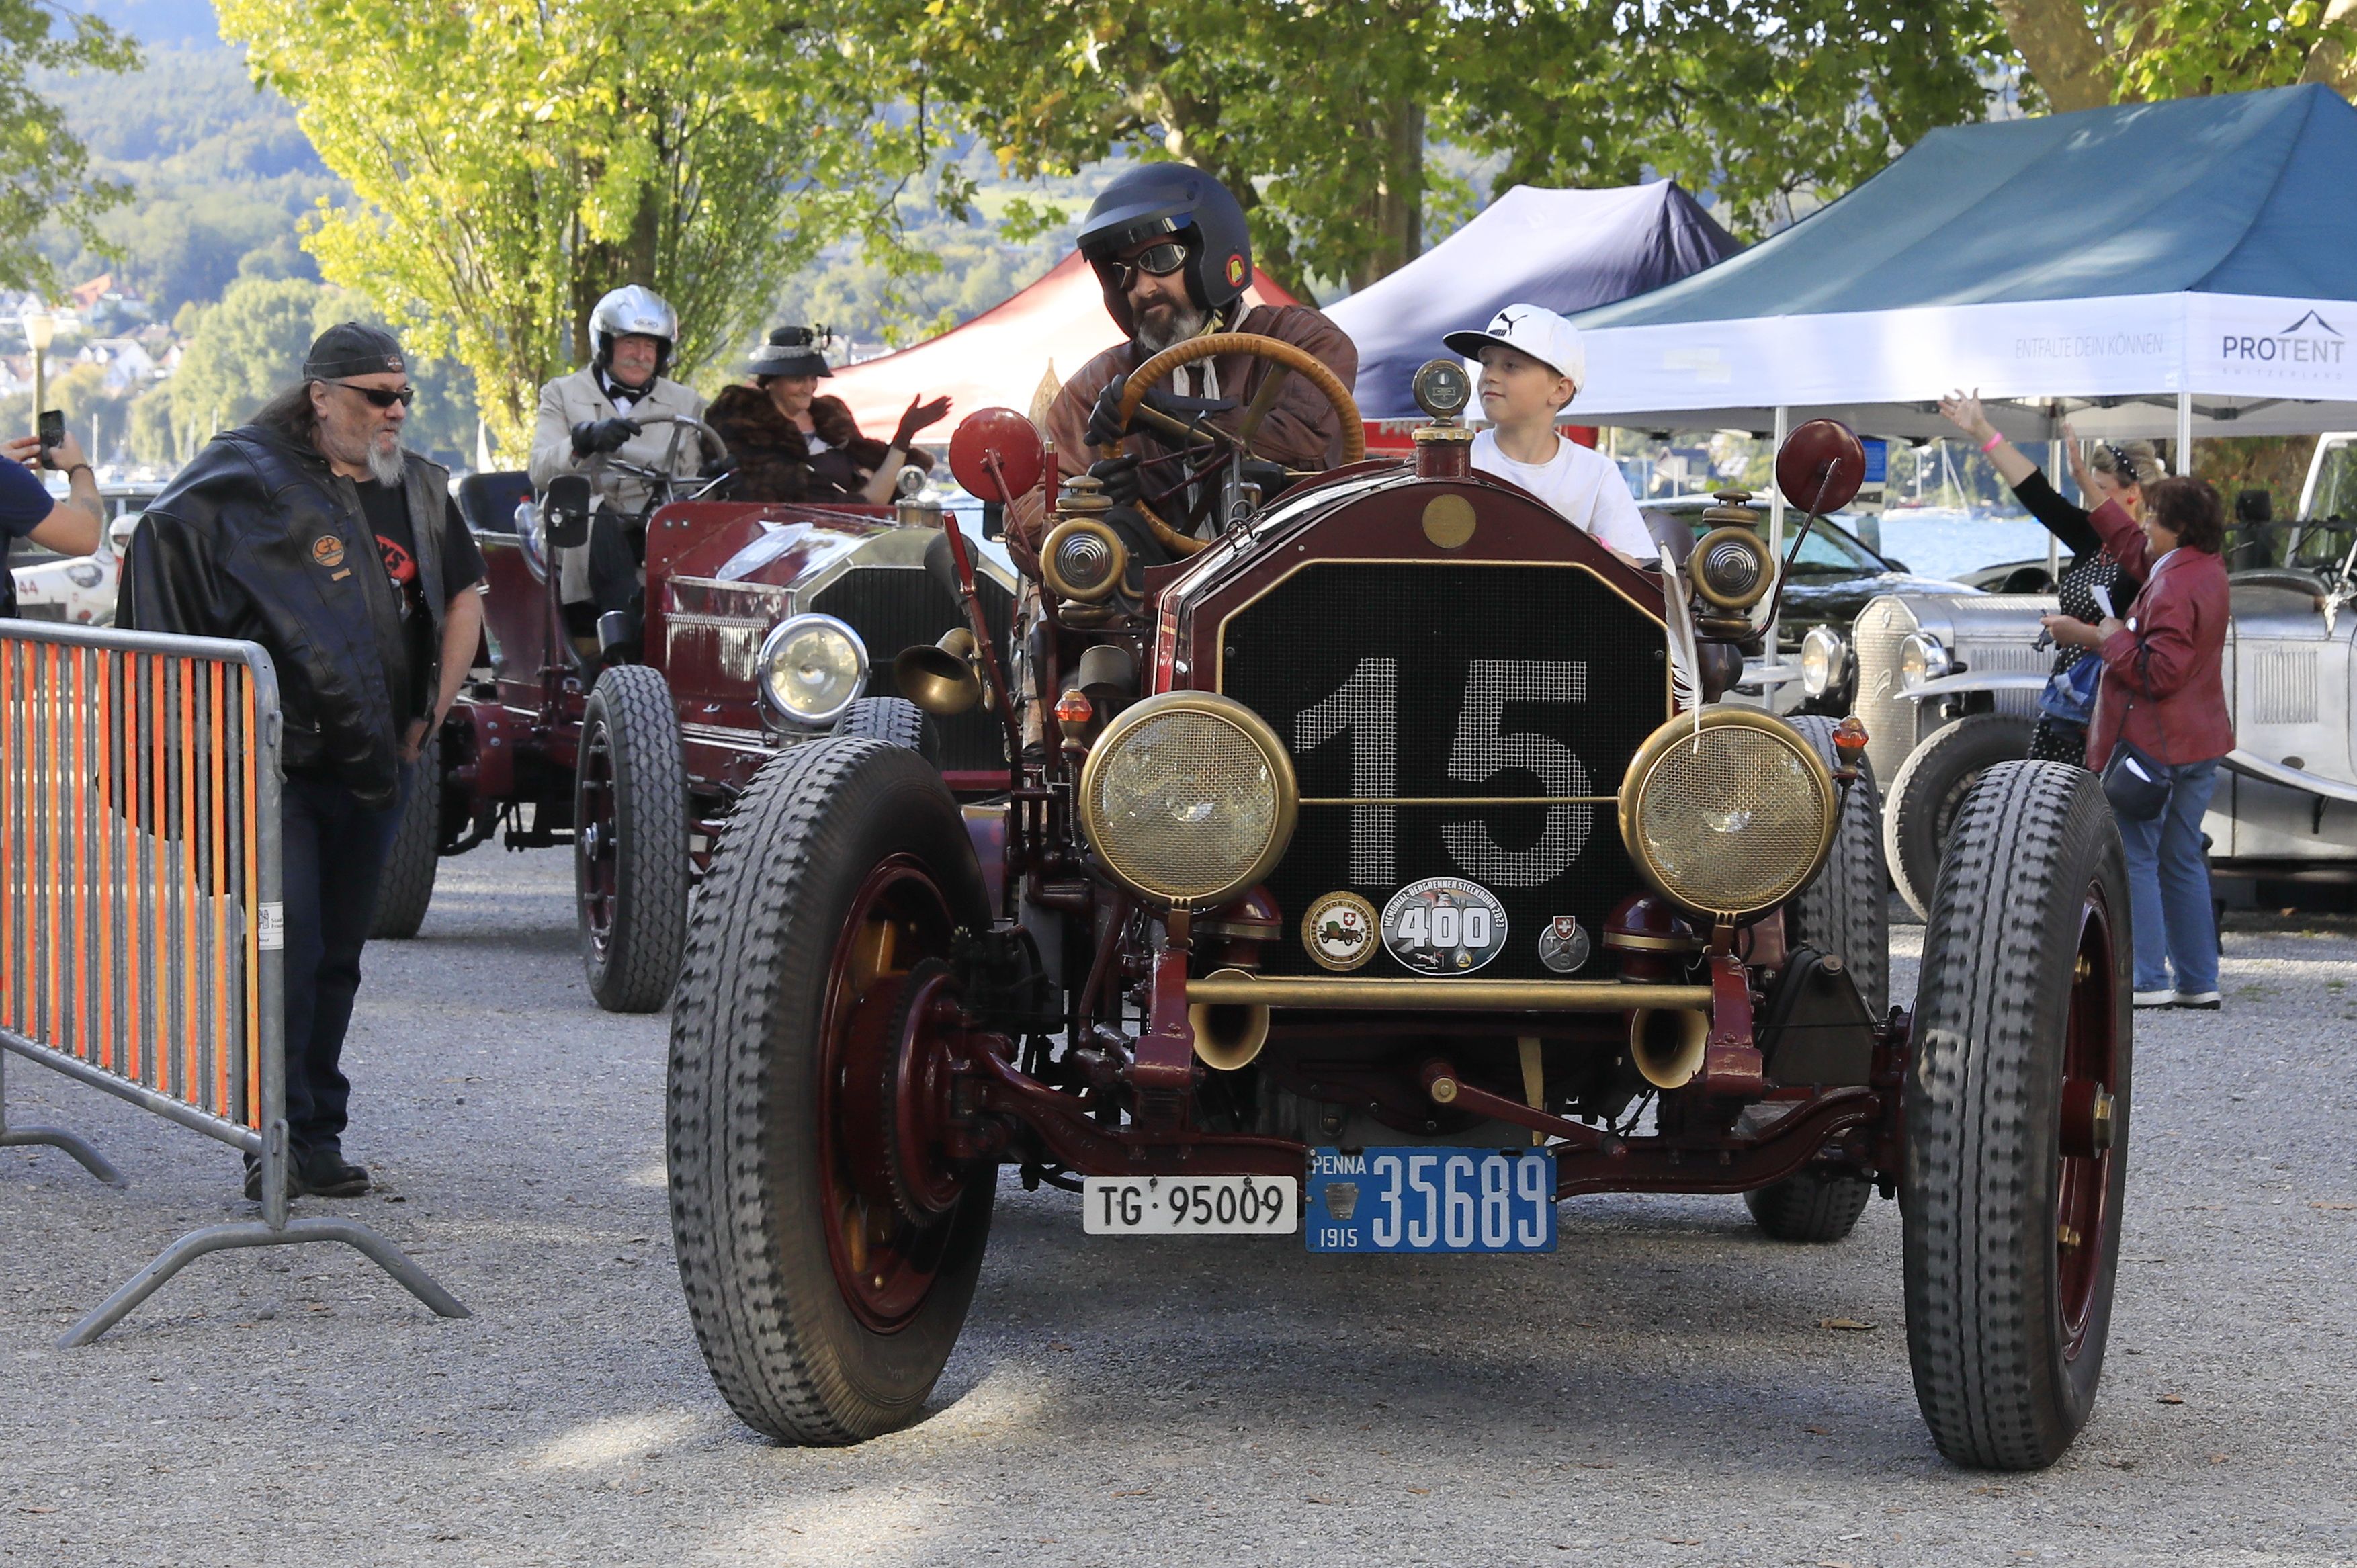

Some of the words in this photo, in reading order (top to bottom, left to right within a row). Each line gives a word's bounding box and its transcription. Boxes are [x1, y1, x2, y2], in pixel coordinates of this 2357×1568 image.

[2016, 337, 2071, 359] ENTFALTE
[2075, 335, 2104, 357] DEIN
[2108, 332, 2163, 356] KÖNNEN
[2223, 336, 2345, 363] PROTENT
[1295, 658, 1594, 887] 15
[1458, 881, 1497, 910] STECKBORN
[1492, 908, 1505, 928] 2023
[1398, 906, 1491, 947] 400
[1097, 1186, 1142, 1226] TG
[1169, 1185, 1283, 1226] 95009
[1312, 1155, 1367, 1175] PENNA
[1373, 1156, 1547, 1248] 35689
[1320, 1228, 1358, 1248] 1915
